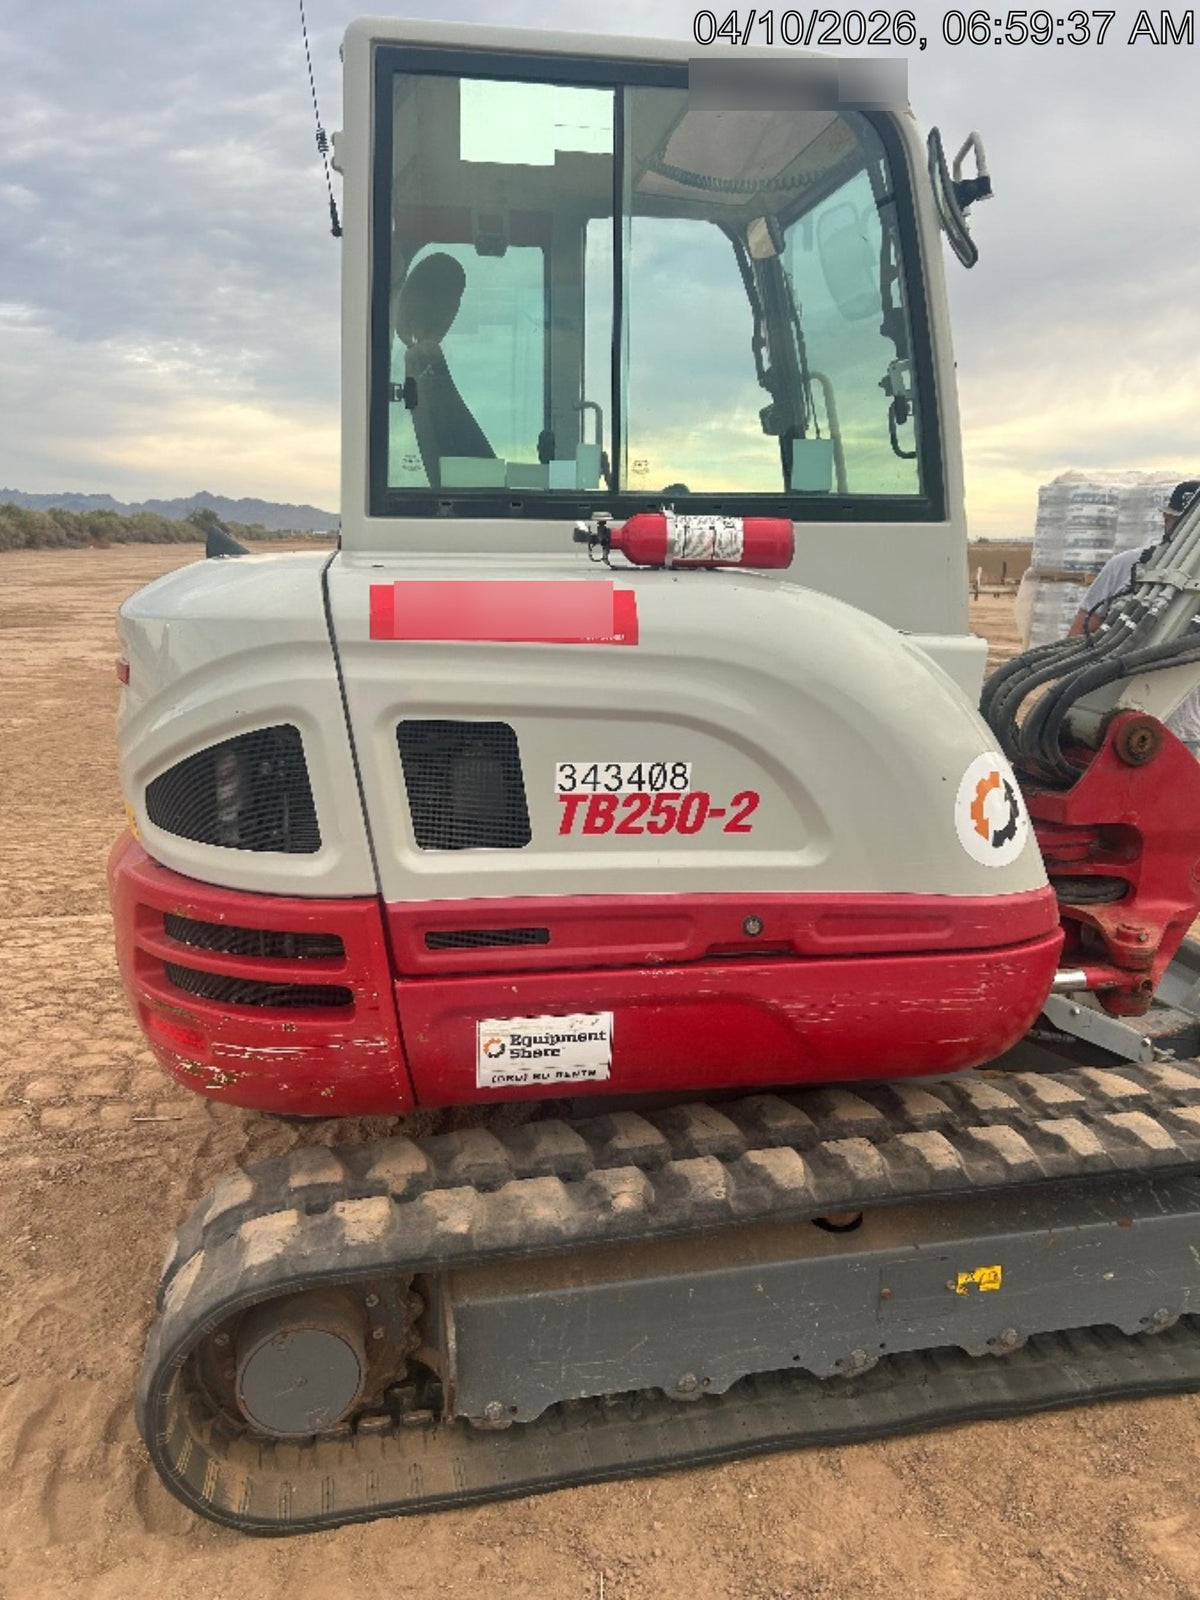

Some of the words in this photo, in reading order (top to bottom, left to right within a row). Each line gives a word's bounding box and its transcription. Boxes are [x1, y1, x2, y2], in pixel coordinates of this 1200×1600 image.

[557, 762, 690, 792] 343408
[558, 790, 760, 835] TB250-2
[509, 1030, 607, 1048] Equipment
